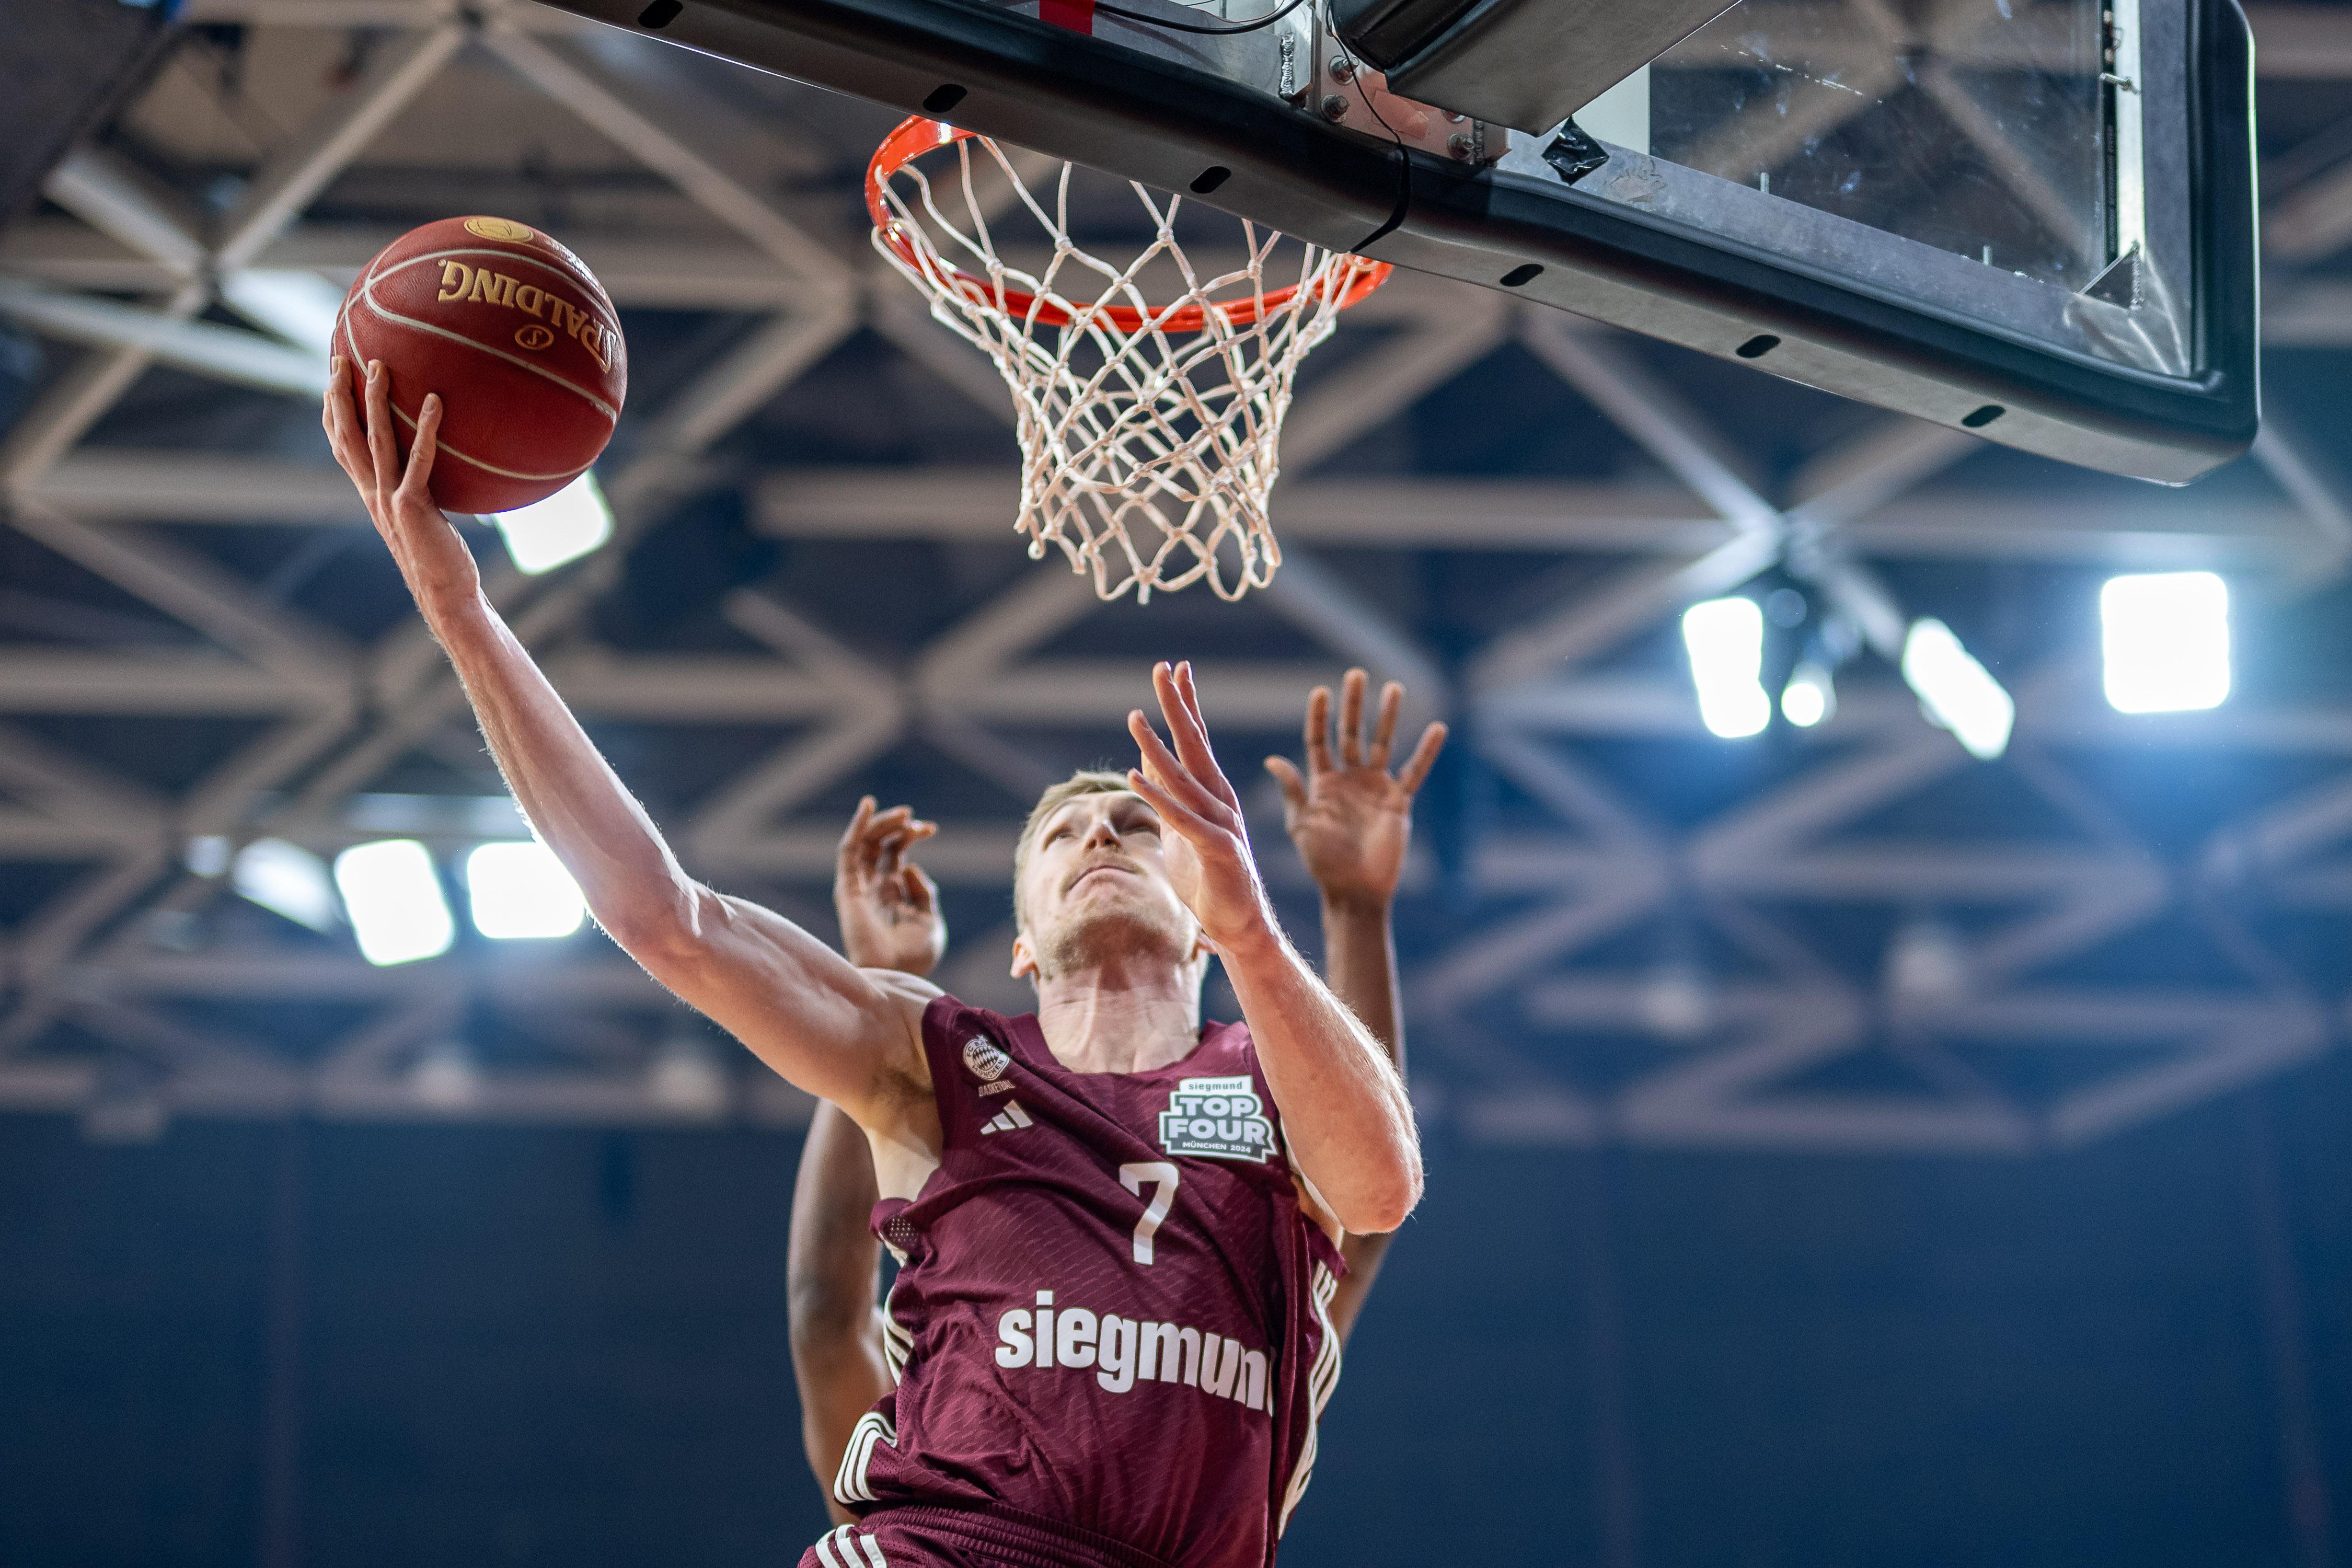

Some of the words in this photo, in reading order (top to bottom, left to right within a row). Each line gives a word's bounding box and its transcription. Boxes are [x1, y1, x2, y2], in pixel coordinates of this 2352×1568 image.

[437, 259, 617, 374] SPALDING
[978, 1080, 1016, 1097] BASKETBALL
[1189, 1081, 1242, 1092] siegmund
[1179, 1097, 1254, 1117] TOP
[1168, 1119, 1266, 1146] FOUR
[1182, 1141, 1227, 1150] MÜNCHEN
[1230, 1145, 1251, 1154] 2024
[1119, 1161, 1180, 1265] 7
[994, 1289, 1273, 1417] siegmun
